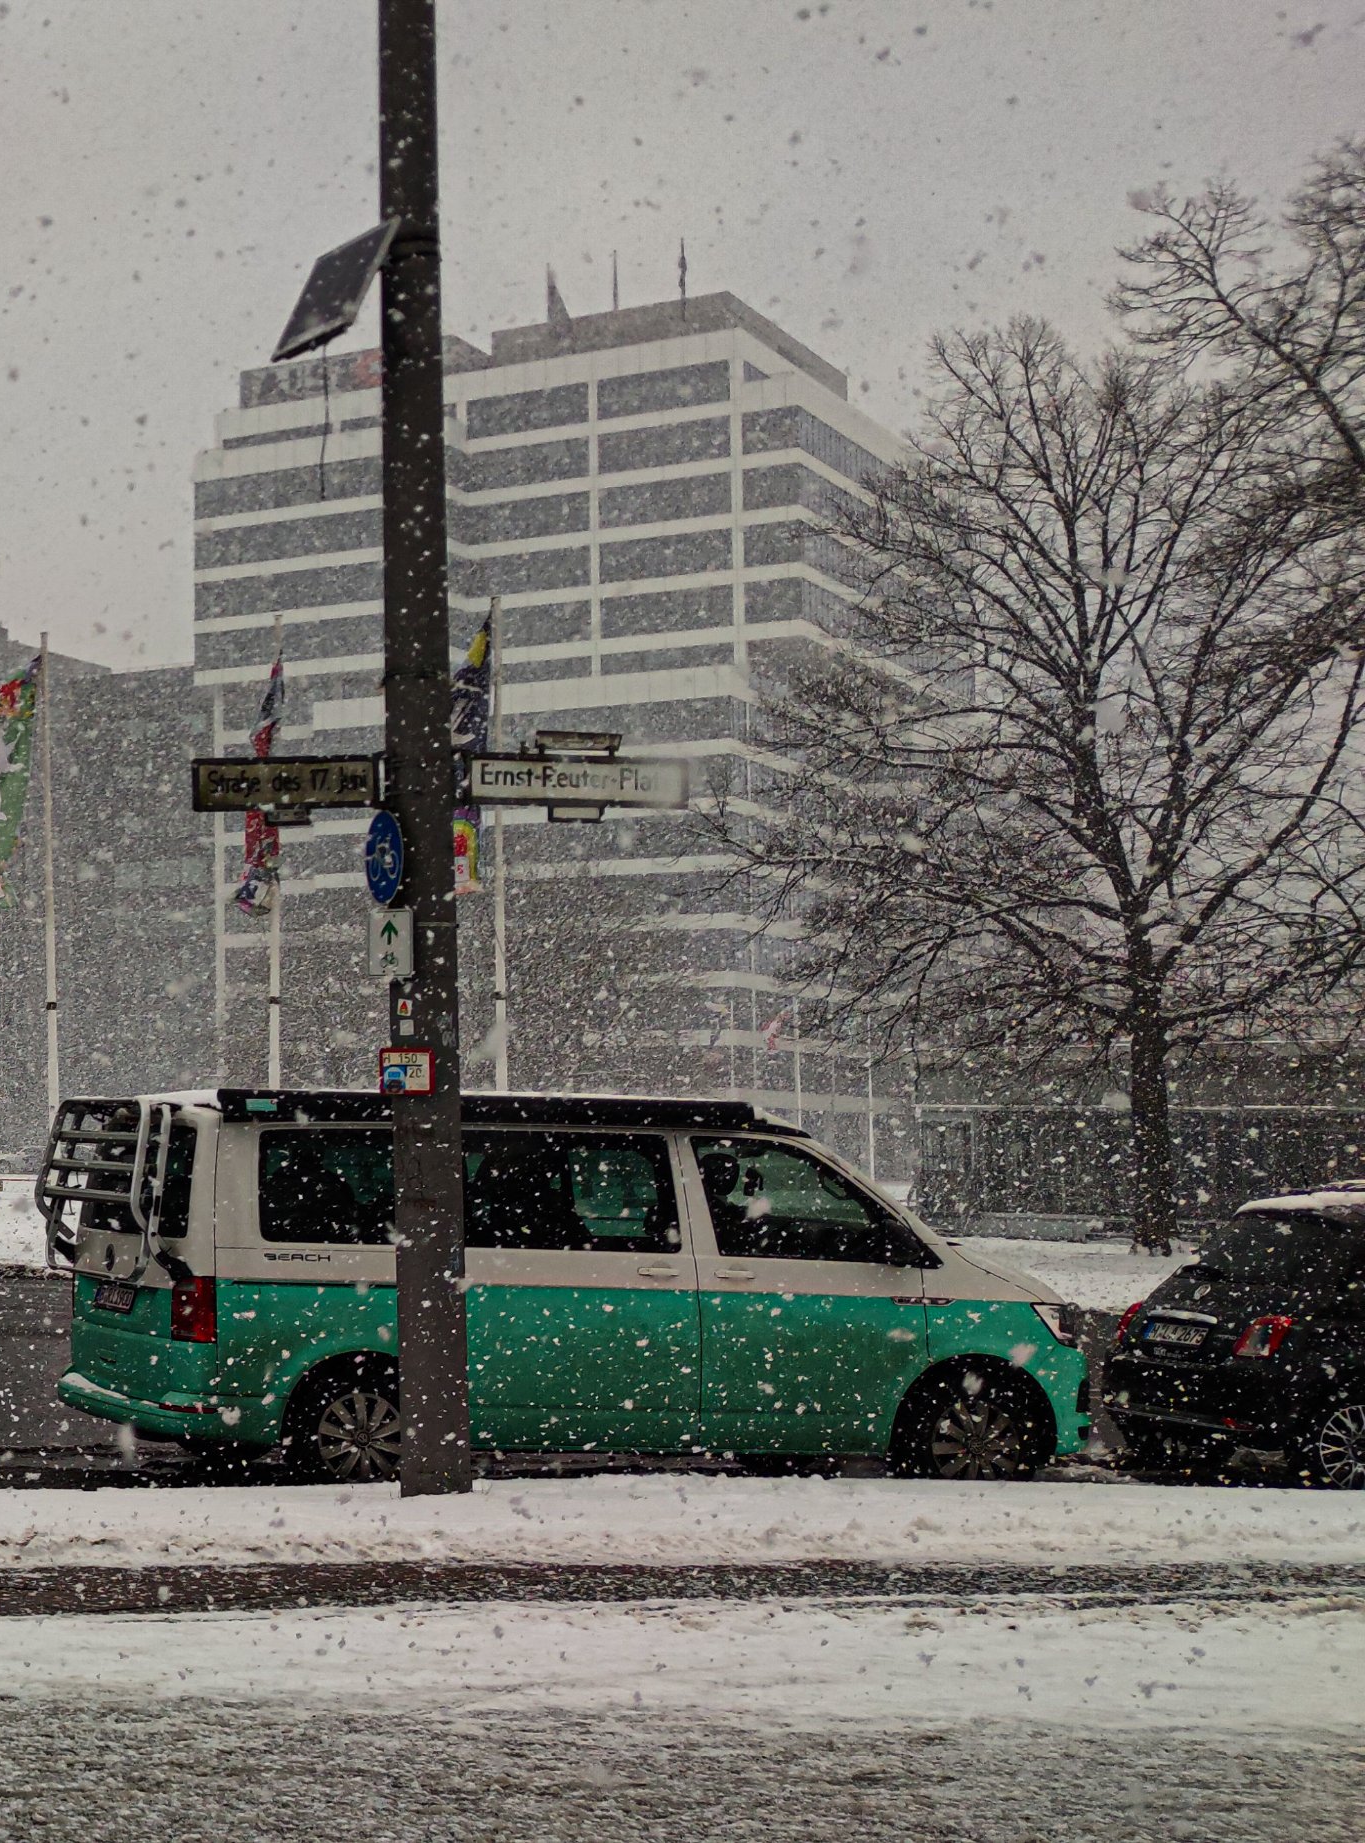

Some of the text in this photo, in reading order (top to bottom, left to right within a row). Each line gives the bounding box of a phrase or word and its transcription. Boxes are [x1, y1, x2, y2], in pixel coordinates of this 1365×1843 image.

[207, 770, 260, 798] Straße
[272, 770, 301, 793] des
[480, 762, 669, 792] Ernst-Reuter-Pla
[398, 1053, 418, 1064] 150
[263, 1253, 331, 1262] BEACH
[1177, 1327, 1207, 1344] 2675
